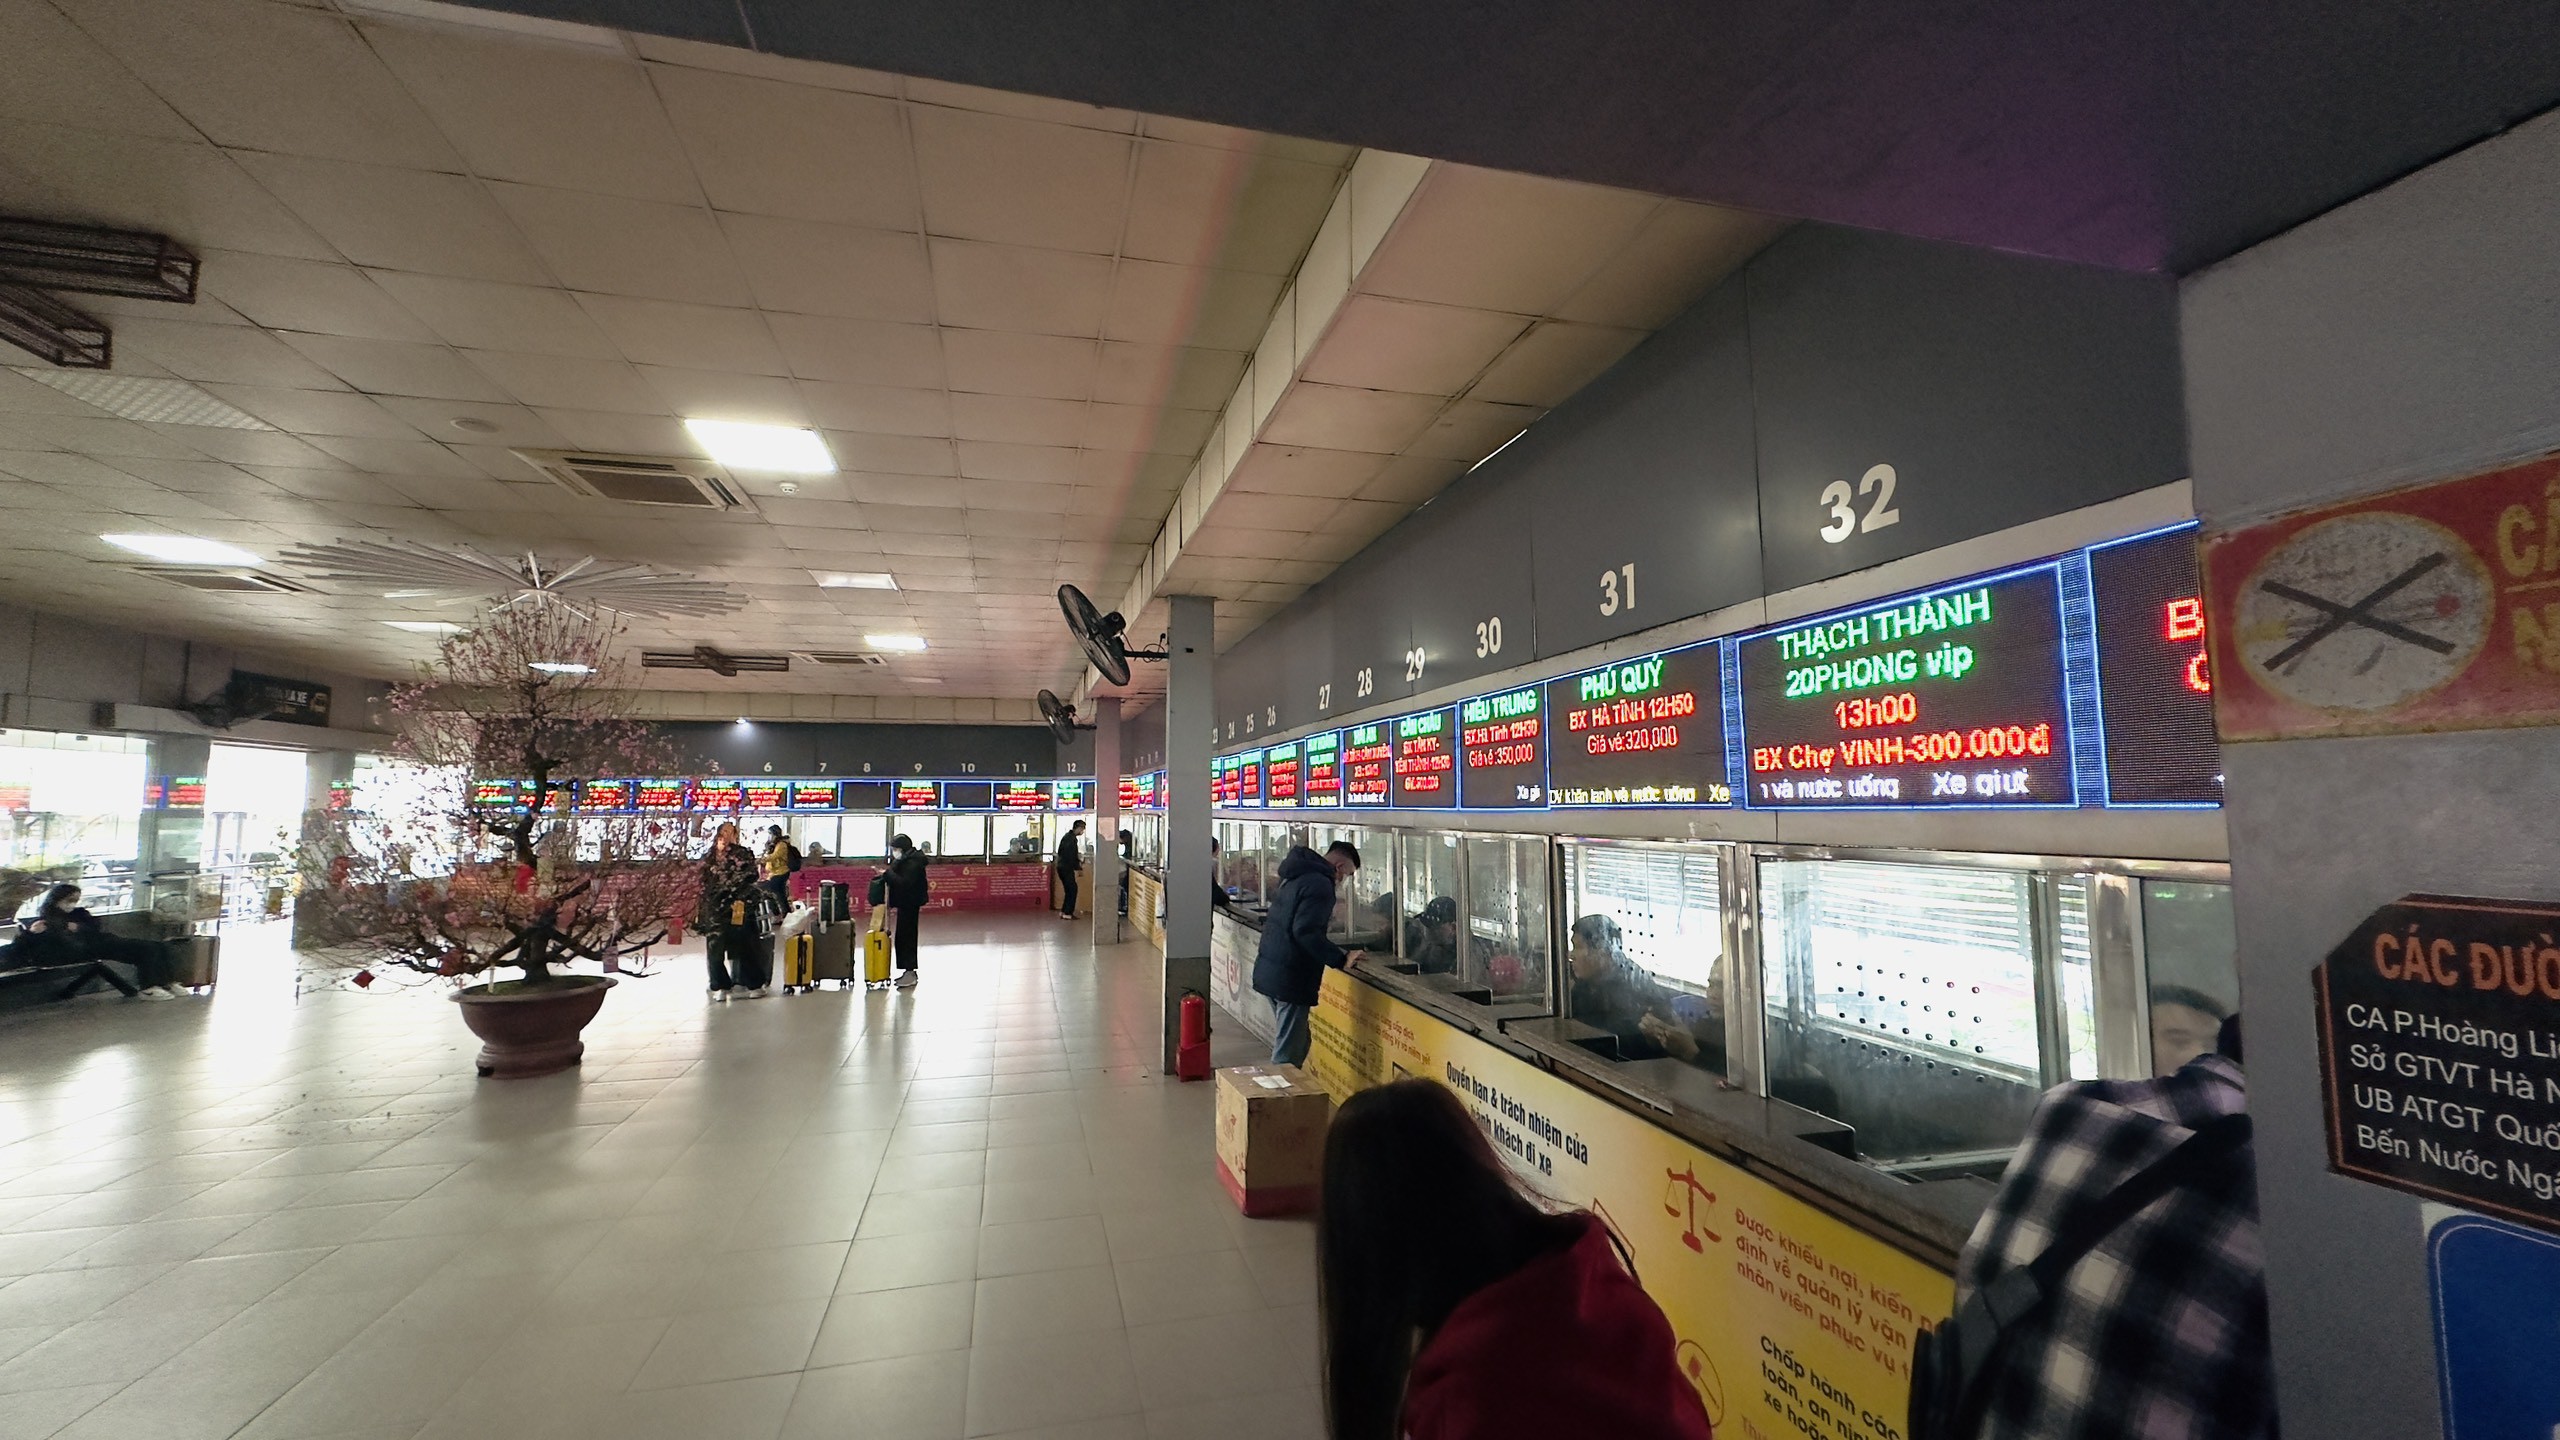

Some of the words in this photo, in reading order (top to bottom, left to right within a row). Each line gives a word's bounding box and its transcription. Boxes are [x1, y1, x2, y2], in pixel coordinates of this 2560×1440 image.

[1820, 464, 1899, 543] 32
[1599, 563, 1636, 616] 31
[1476, 616, 1502, 658] 30
[1777, 616, 1869, 660] THẠCH
[1406, 646, 1426, 682] 29
[1581, 664, 1617, 700] PHÚ
[1621, 653, 1663, 693] QUÝ
[1786, 649, 1917, 697] 20PHONG
[1925, 641, 1974, 678] vip
[1319, 684, 1331, 710] 27
[1357, 668, 1373, 698] 28
[1266, 706, 1276, 726] 26
[1492, 690, 1537, 718] TRUNG
[1569, 709, 1588, 731] BX
[1592, 703, 1611, 727] HÀ
[1649, 692, 1695, 719] 12H50
[1835, 692, 1918, 729] 13h00
[1228, 721, 1236, 739] 24
[1246, 713, 1255, 733] 25
[1587, 733, 1607, 755] Giá
[1754, 746, 1784, 771] BX
[1788, 744, 1835, 774] Chợ
[763, 762, 773, 773] 6
[819, 762, 828, 773] 7
[863, 762, 871, 773] 8
[914, 763, 923, 773] 9
[961, 763, 976, 773] 10
[1014, 763, 1028, 773] 11
[1066, 762, 1077, 773] 12
[1708, 784, 1731, 802] Xe
[1932, 770, 1968, 796] Xe
[962, 866, 970, 875] 6
[1041, 865, 1048, 874] 7
[929, 881, 937, 890] 9
[940, 898, 954, 907] 10
[2375, 923, 2460, 987] CÁC
[2529, 1030, 2560, 1059] Li
[2351, 1043, 2387, 1072] Sở
[2395, 1052, 2480, 1089] GTVT
[2490, 1068, 2535, 1100] Hà
[1472, 1076, 1488, 1104] hạn
[1491, 1087, 1498, 1109] &
[1500, 1092, 1526, 1127] trách
[1528, 1111, 1562, 1149] nhiệm
[1565, 1132, 1588, 1165] của
[2354, 1084, 2395, 1113] UB
[2402, 1095, 2486, 1133] ATGT
[1494, 1119, 1523, 1157] khách
[1526, 1141, 1536, 1166] đi
[1539, 1151, 1552, 1176] xe
[2357, 1124, 2411, 1160] Bến
[2419, 1138, 2498, 1181] Nước
[1735, 1207, 1774, 1241] Được
[1779, 1231, 1824, 1271] khiếu
[1870, 1281, 1913, 1323] kiến
[1736, 1235, 1768, 1266] định
[1773, 1255, 1792, 1279] về
[1797, 1272, 1842, 1311] quản
[1847, 1298, 1863, 1325] lý
[1869, 1315, 1907, 1350] vận
[1737, 1260, 1775, 1295] nhân
[1779, 1287, 1814, 1320] viên
[1819, 1313, 1866, 1352] phục
[1872, 1345, 1896, 1376] vụ
[1760, 1335, 1806, 1379] Chấp
[1810, 1368, 1856, 1416] hành
[1762, 1359, 1804, 1408] toàn,
[1808, 1398, 1832, 1426] an
[1763, 1389, 1783, 1414] xe
